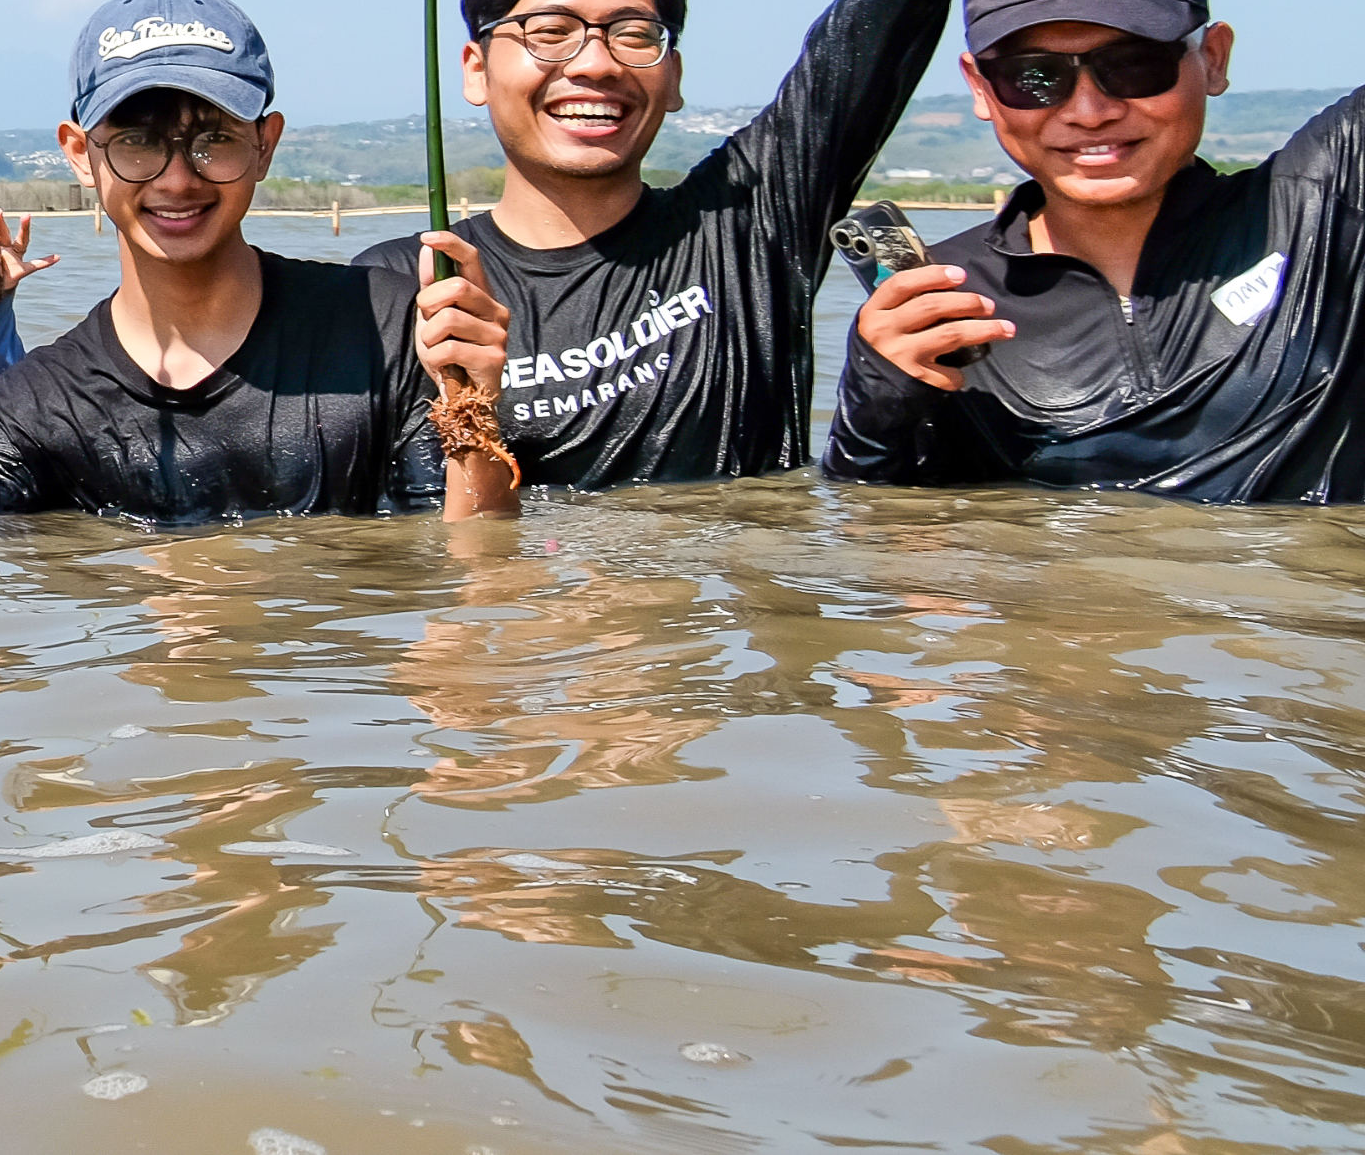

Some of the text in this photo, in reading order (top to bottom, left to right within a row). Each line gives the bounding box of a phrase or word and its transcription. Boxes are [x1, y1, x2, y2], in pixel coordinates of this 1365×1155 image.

[98, 16, 231, 57] San Francisco
[513, 352, 670, 421] SEMARANG
